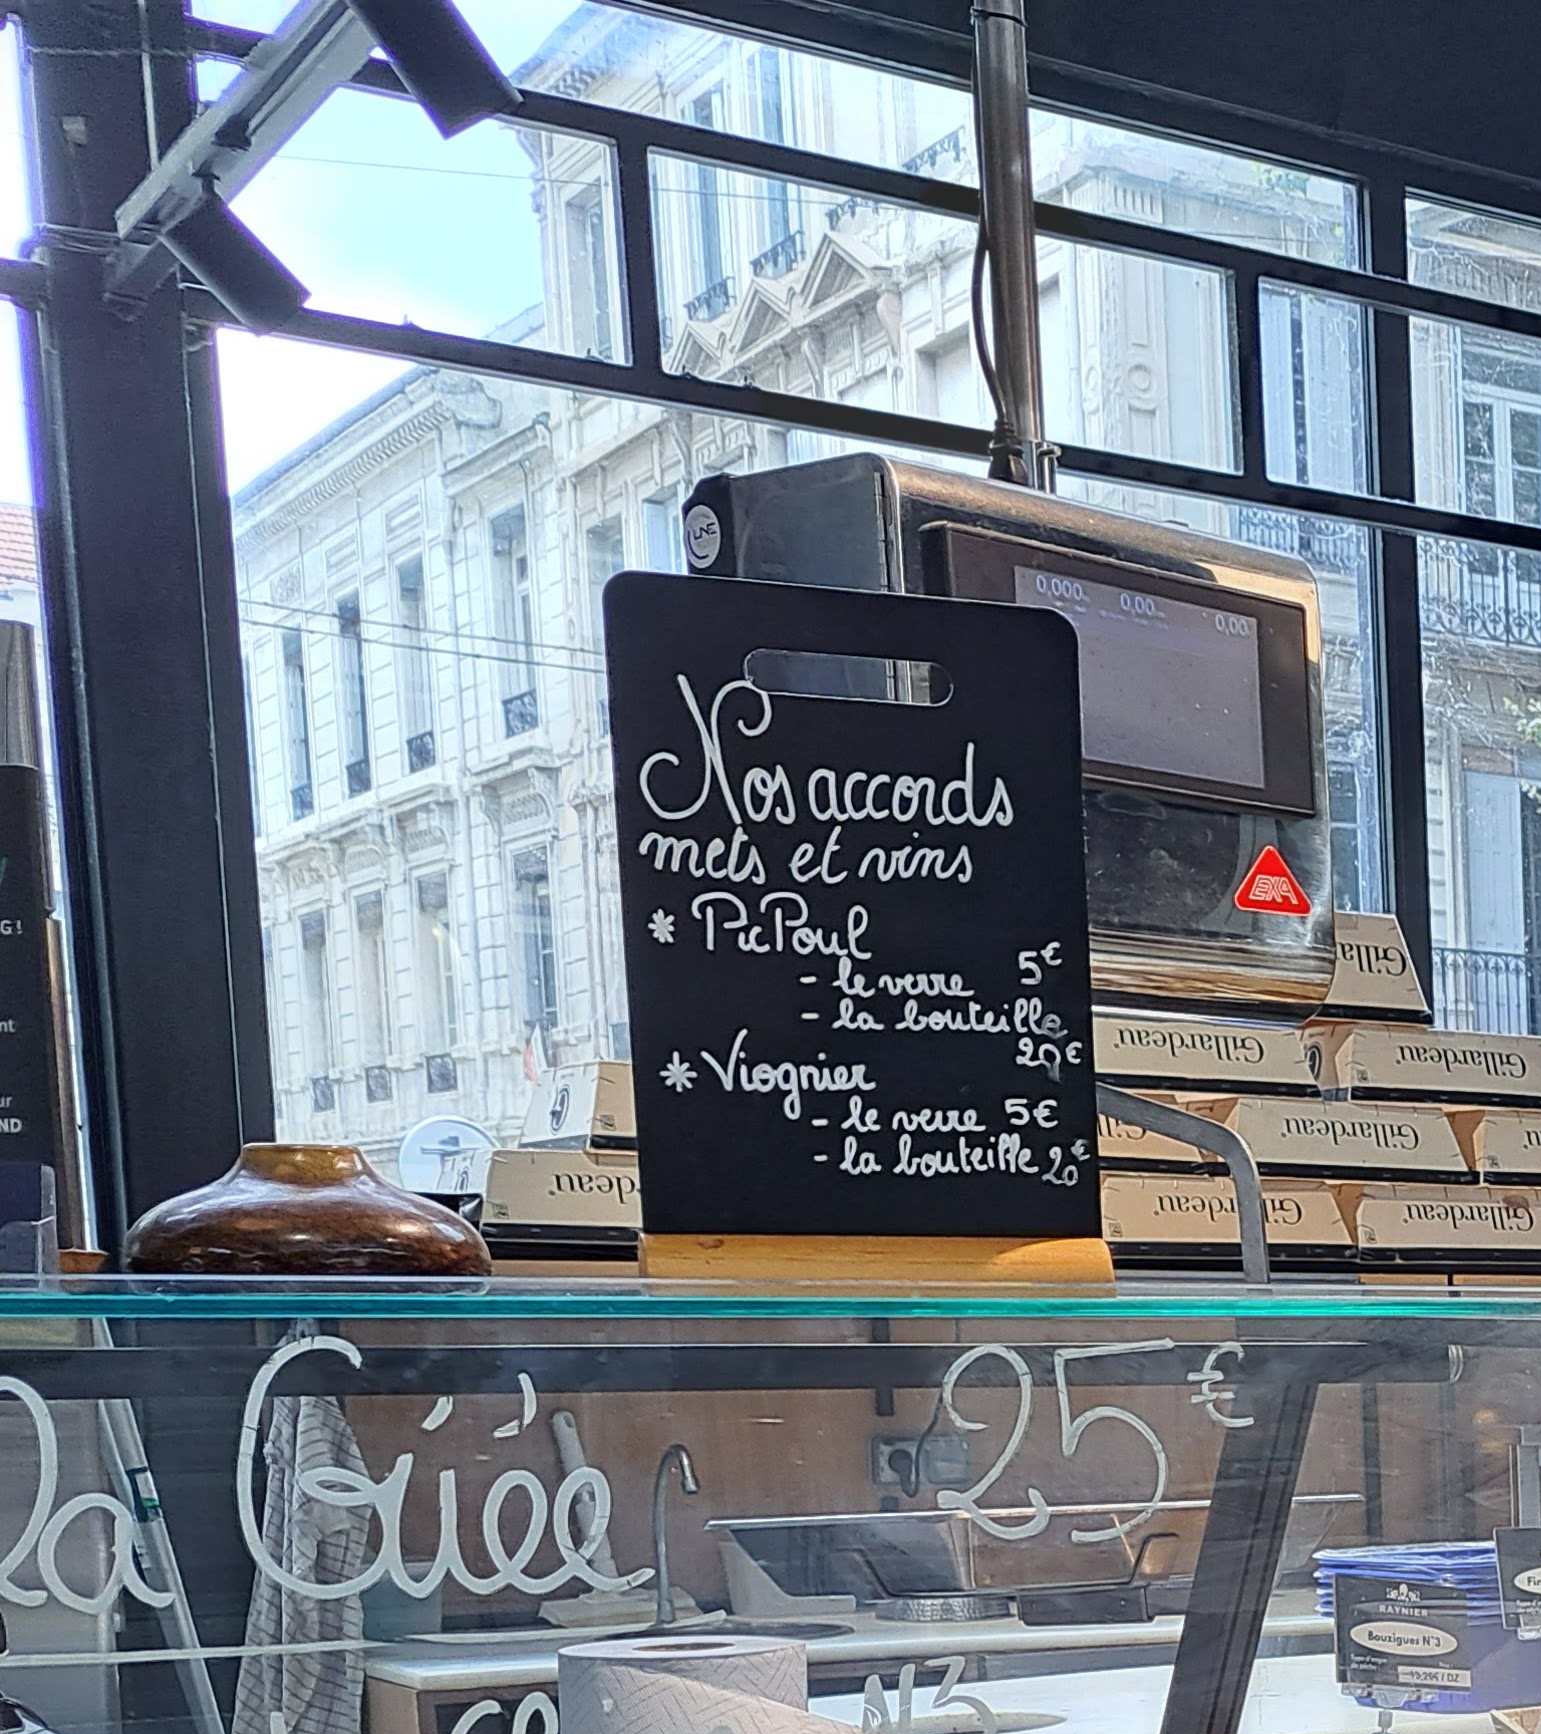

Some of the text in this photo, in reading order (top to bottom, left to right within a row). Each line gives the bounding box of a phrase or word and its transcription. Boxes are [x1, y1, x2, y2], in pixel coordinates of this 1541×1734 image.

[640, 673, 1014, 827] Nos accords
[638, 825, 974, 885] mets et vins
[1248, 873, 1300, 905] EXA
[832, 941, 1063, 998] le verre 5€
[832, 996, 1069, 1040] la bouteille
[1113, 1026, 1265, 1065] Gillardeau
[1395, 1044, 1528, 1080] Gillardeau
[700, 1028, 878, 1121] Viognier
[840, 1094, 1060, 1134] le verre 5€
[1280, 1115, 1420, 1151] Gillardeau
[838, 1135, 884, 1177] la
[892, 1131, 1040, 1179] bouteille
[1402, 1203, 1535, 1232] Gillardeau
[1378, 1604, 1429, 1618] RAYNIER
[1367, 1629, 1421, 1648] Bouzigues
